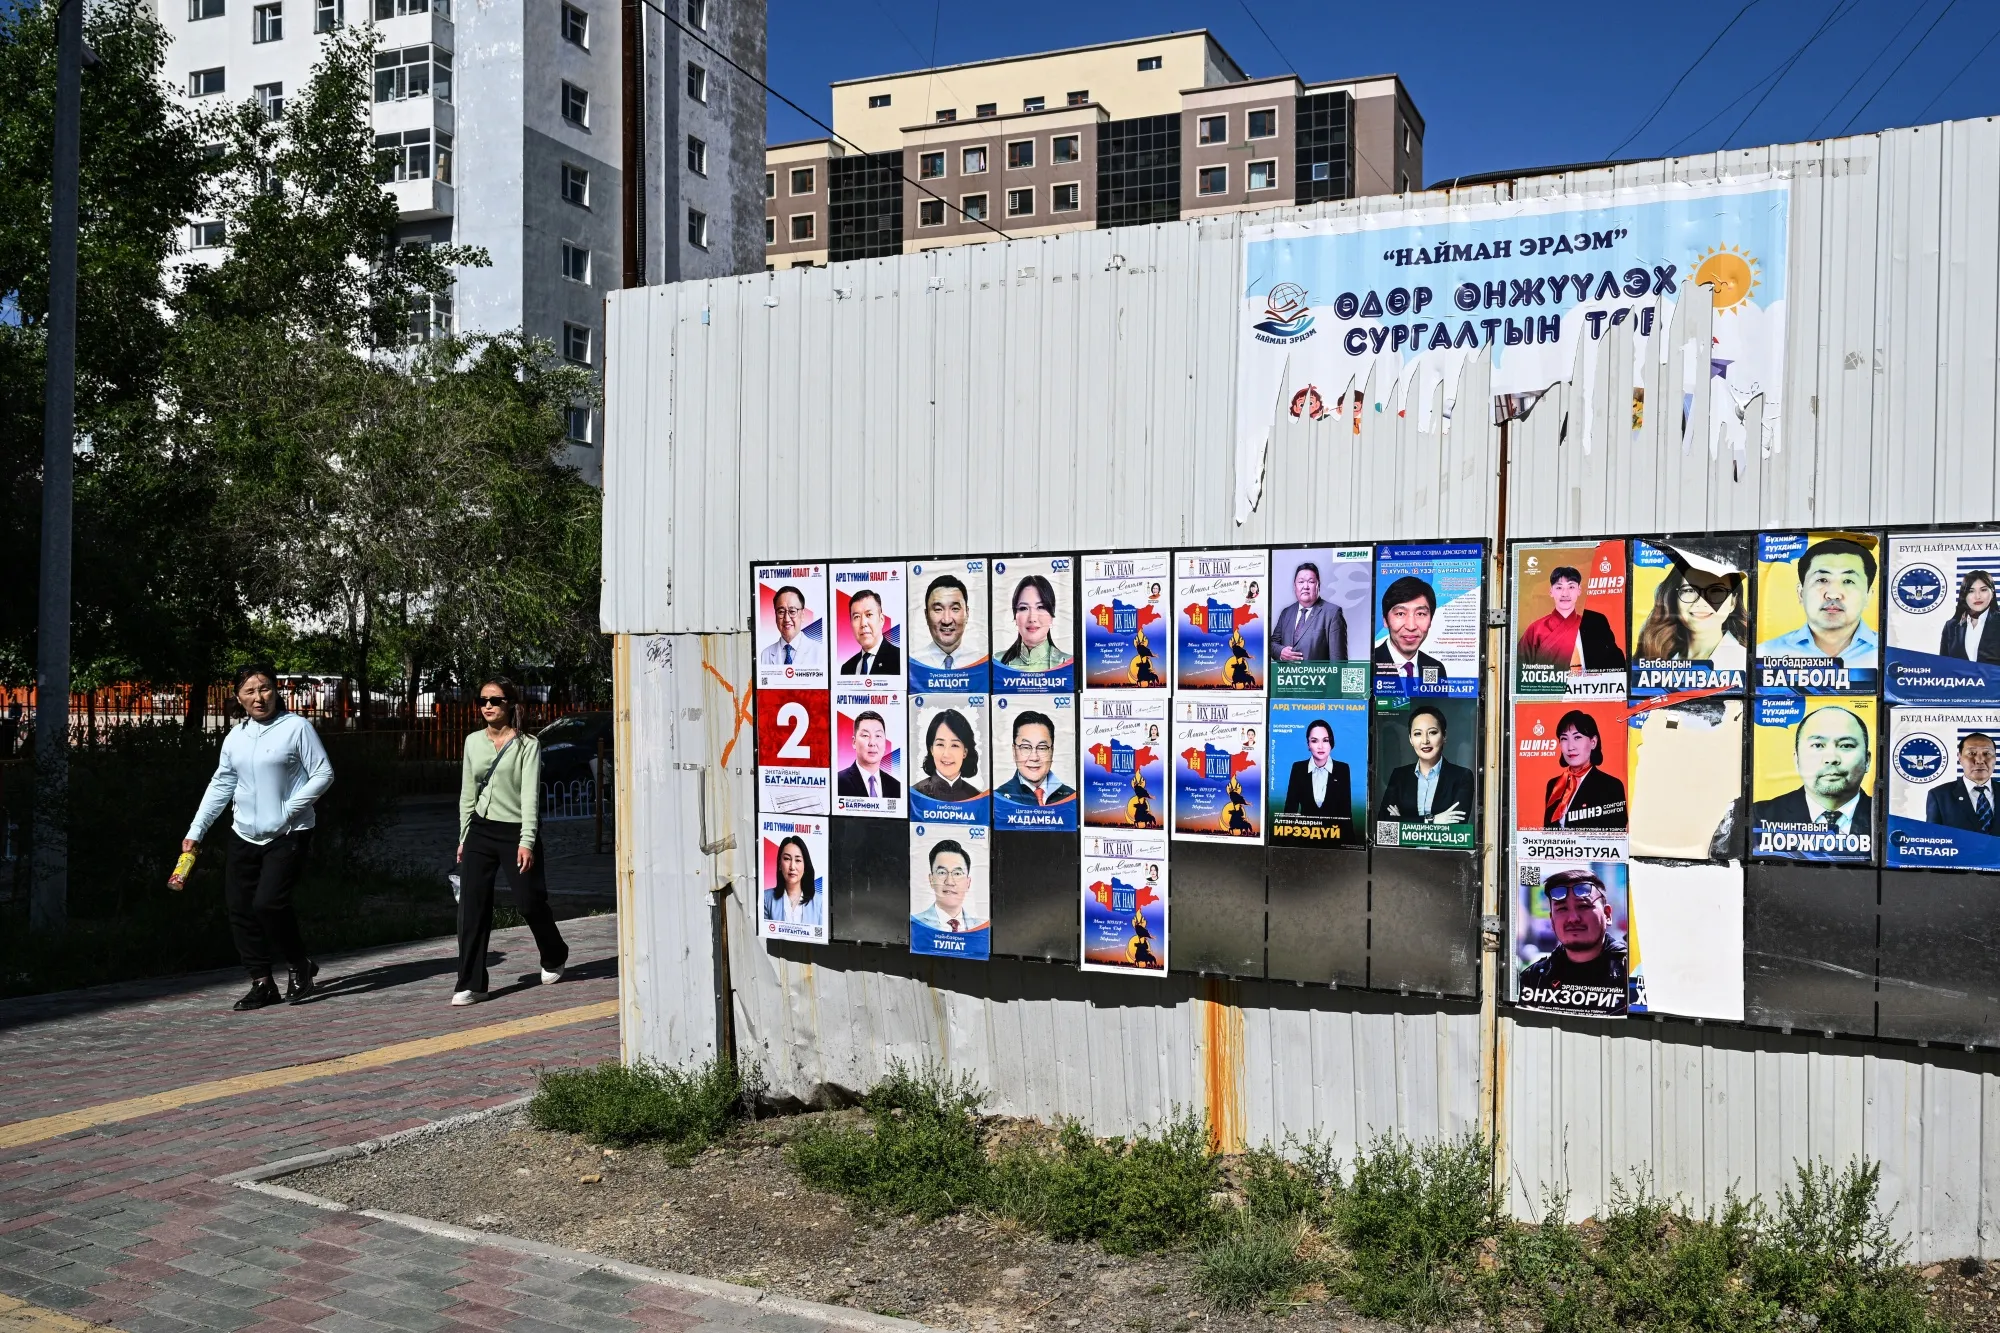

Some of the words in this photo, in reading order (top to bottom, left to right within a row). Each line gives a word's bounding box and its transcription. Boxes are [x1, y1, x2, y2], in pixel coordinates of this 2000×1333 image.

[1334, 286, 1434, 321] ӨДӨР
[1454, 264, 1678, 311] ӨНЖҮҮЛЭХ
[1344, 314, 1561, 357] СУРГАЛТЫН
[1765, 535, 1798, 543] Бүхнийг
[1765, 543, 1802, 552] хүүхдийн
[1899, 545, 1922, 554] БҮГД
[1923, 542, 1983, 553] НАЙРАМДАХ
[1765, 551, 1790, 560] төлөө!
[759, 568, 770, 579] АРД
[792, 567, 810, 578] ЯЛАЛТ
[1117, 563, 1134, 576] НАМ
[1213, 561, 1231, 574] НАМ
[836, 572, 847, 583] АРД
[870, 571, 888, 582] ЯЛАЛТ
[1587, 576, 1625, 589] ШИНЭ
[1124, 613, 1137, 629] НАМ
[1219, 612, 1232, 629] НАМ
[1638, 659, 1692, 670] Батбаярын
[1763, 656, 1833, 669] Цогбадрахын
[1277, 666, 1338, 674] ЖАМСРАНЖАВ
[1897, 666, 1931, 675] Рэнцэн
[928, 678, 969, 688] БАТЦОГТ
[1003, 678, 1067, 688] УУГАНЦЭЦЭГ
[1277, 675, 1326, 686] БАТСҮХ
[1376, 680, 1383, 690] 8
[1637, 670, 1744, 689] АРИУНЗАЯА
[1762, 669, 1850, 690] БАТБОЛД
[1896, 677, 1985, 688] СҮНЖИДМАА
[1420, 685, 1475, 693] ОЛОНБАЯР
[837, 694, 847, 704] АРД
[870, 695, 888, 704] ЯЛАЛТ
[1115, 703, 1132, 716] НАМ
[1272, 703, 1290, 711] АРД
[1291, 702, 1326, 711] ТҮМНИЙ
[1762, 708, 1800, 716] хүүхдийн
[1211, 707, 1228, 720] НАМ
[1900, 715, 1922, 723] БҮГД
[1924, 714, 1983, 723] НАЙРАМДАХ
[777, 702, 810, 759] 2
[1519, 739, 1558, 751] ШИНЭ
[1121, 753, 1134, 769] НАМ
[1216, 758, 1230, 775] НАМ
[765, 775, 826, 786] БАТ-АМГАЛАН
[923, 810, 976, 821] БОЛОРМАА
[1007, 814, 1064, 825] ЖАДАМБАА
[1567, 806, 1602, 822] ШИНЭ
[763, 822, 774, 831] АРД
[795, 824, 811, 834] ЯЛАЛТ
[1273, 824, 1341, 840] ИРЭЭДҮЙ
[1401, 823, 1450, 831] ДАМДИНСҮРЭН
[1401, 831, 1471, 843] МӨНХЦЭЦЭГ
[1522, 837, 1576, 846] Энхтуяагийн
[1759, 833, 1871, 853] ДОРЖГОТОВ
[1899, 836, 1953, 844] Лувсандорж
[1116, 842, 1133, 855] НАМ
[1528, 846, 1620, 859] ЭРДЭНЭТУЯА
[1899, 846, 1959, 857] БАТБАЯР
[1122, 892, 1135, 908] НАМ
[933, 940, 966, 951] ТУЛГАТ
[1561, 984, 1624, 994] ЭРДЭНЭЧИМЭГИЙН
[1521, 986, 1625, 1008] ЭНХЗОРИГ
